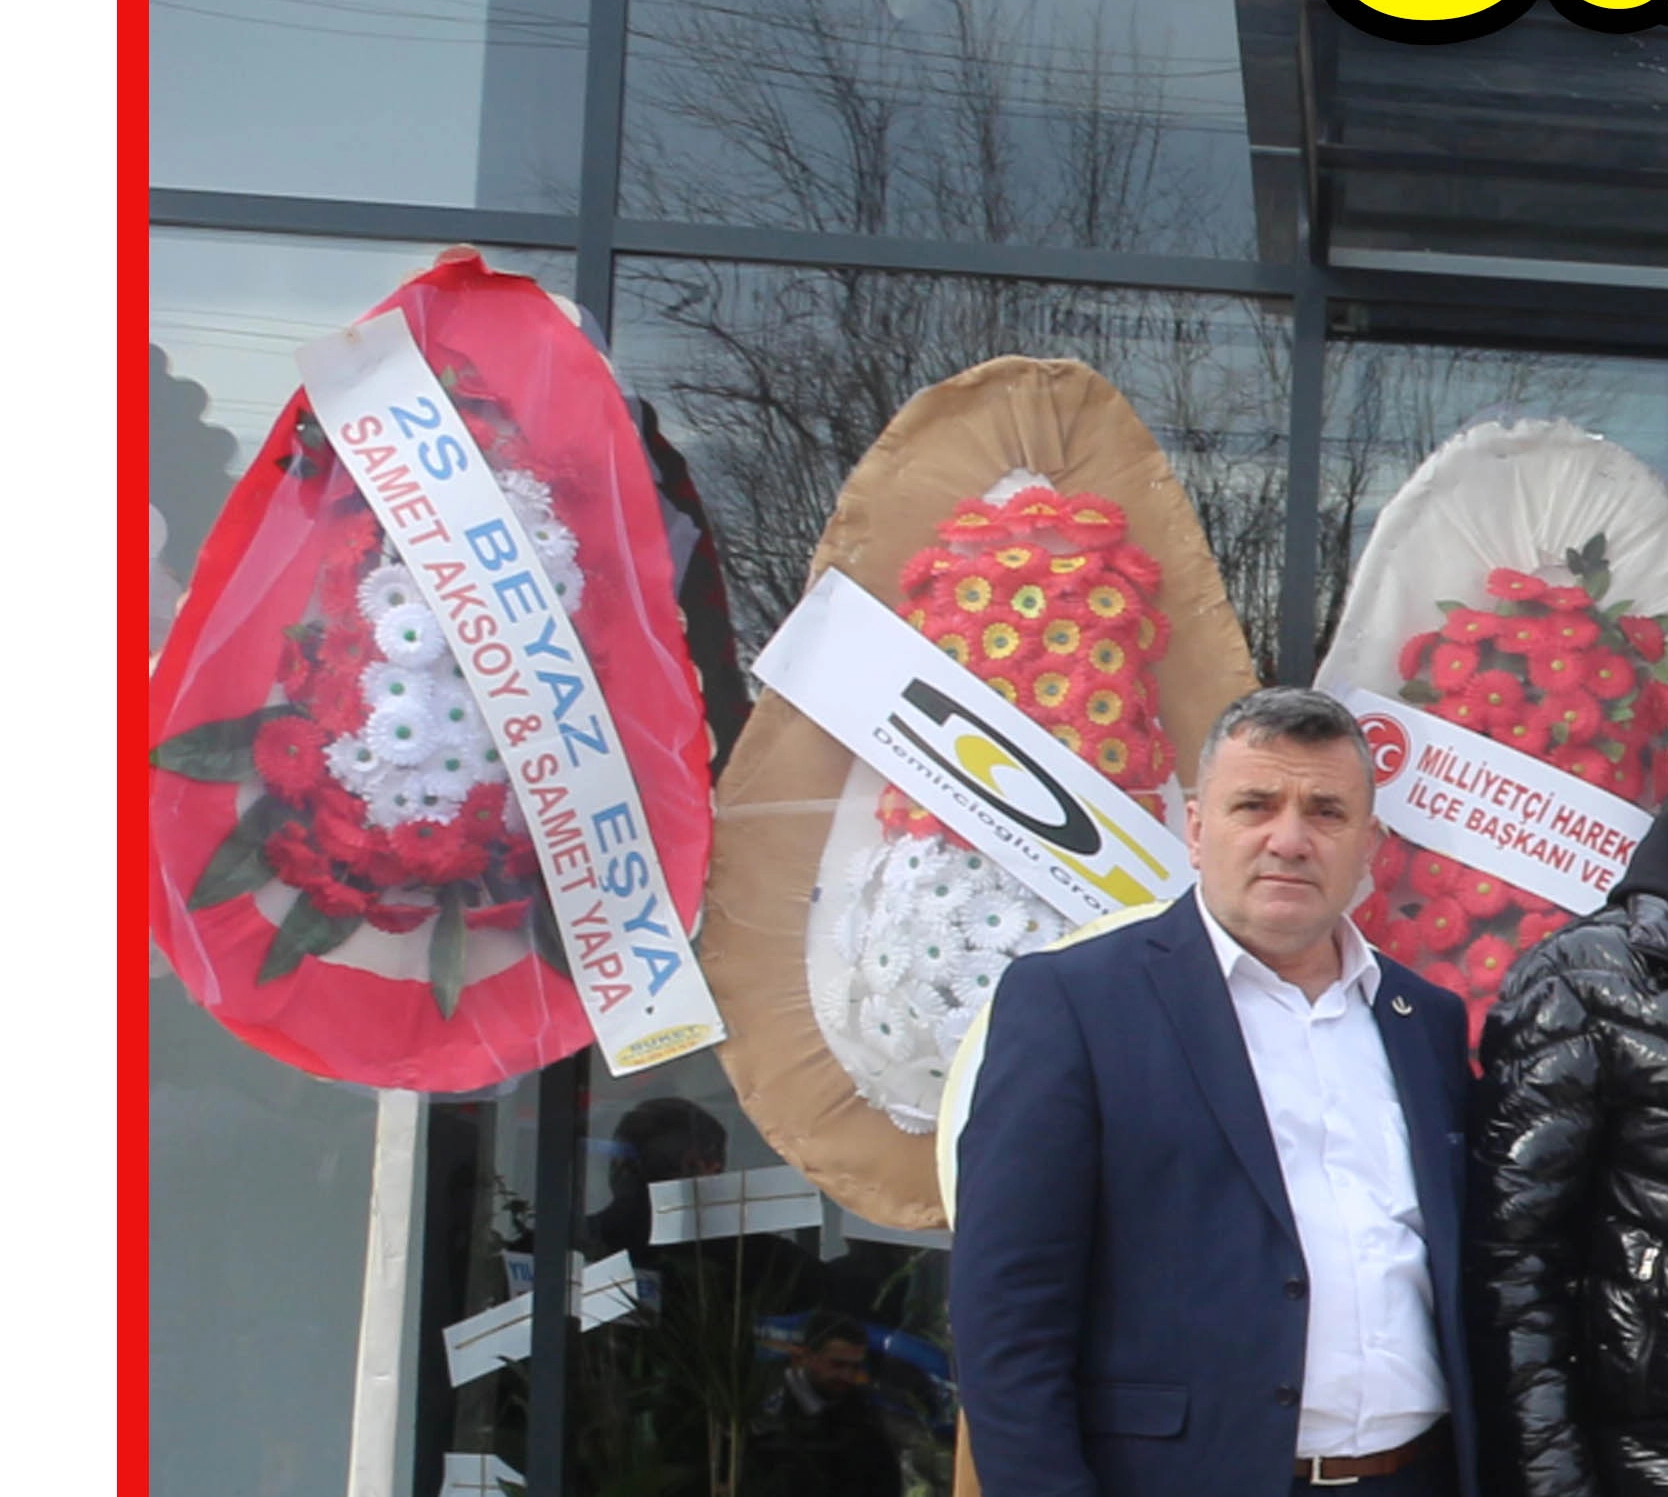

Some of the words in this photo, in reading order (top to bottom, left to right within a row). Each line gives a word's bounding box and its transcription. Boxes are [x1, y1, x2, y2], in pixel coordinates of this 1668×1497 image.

[339, 414, 452, 547] SAMET
[388, 396, 469, 481] 2S
[463, 517, 610, 768] BEYAZ
[423, 560, 530, 700] AKSOY
[502, 713, 543, 747] &
[872, 726, 1041, 863] Demircioglu
[1416, 743, 1556, 825] MİLLİYETÇİ
[520, 752, 598, 893] SAMET
[1406, 775, 1465, 822] İLÇE
[1464, 807, 1578, 875] BAŞKANI
[1581, 857, 1616, 893] VE
[570, 899, 634, 1015] YAPA
